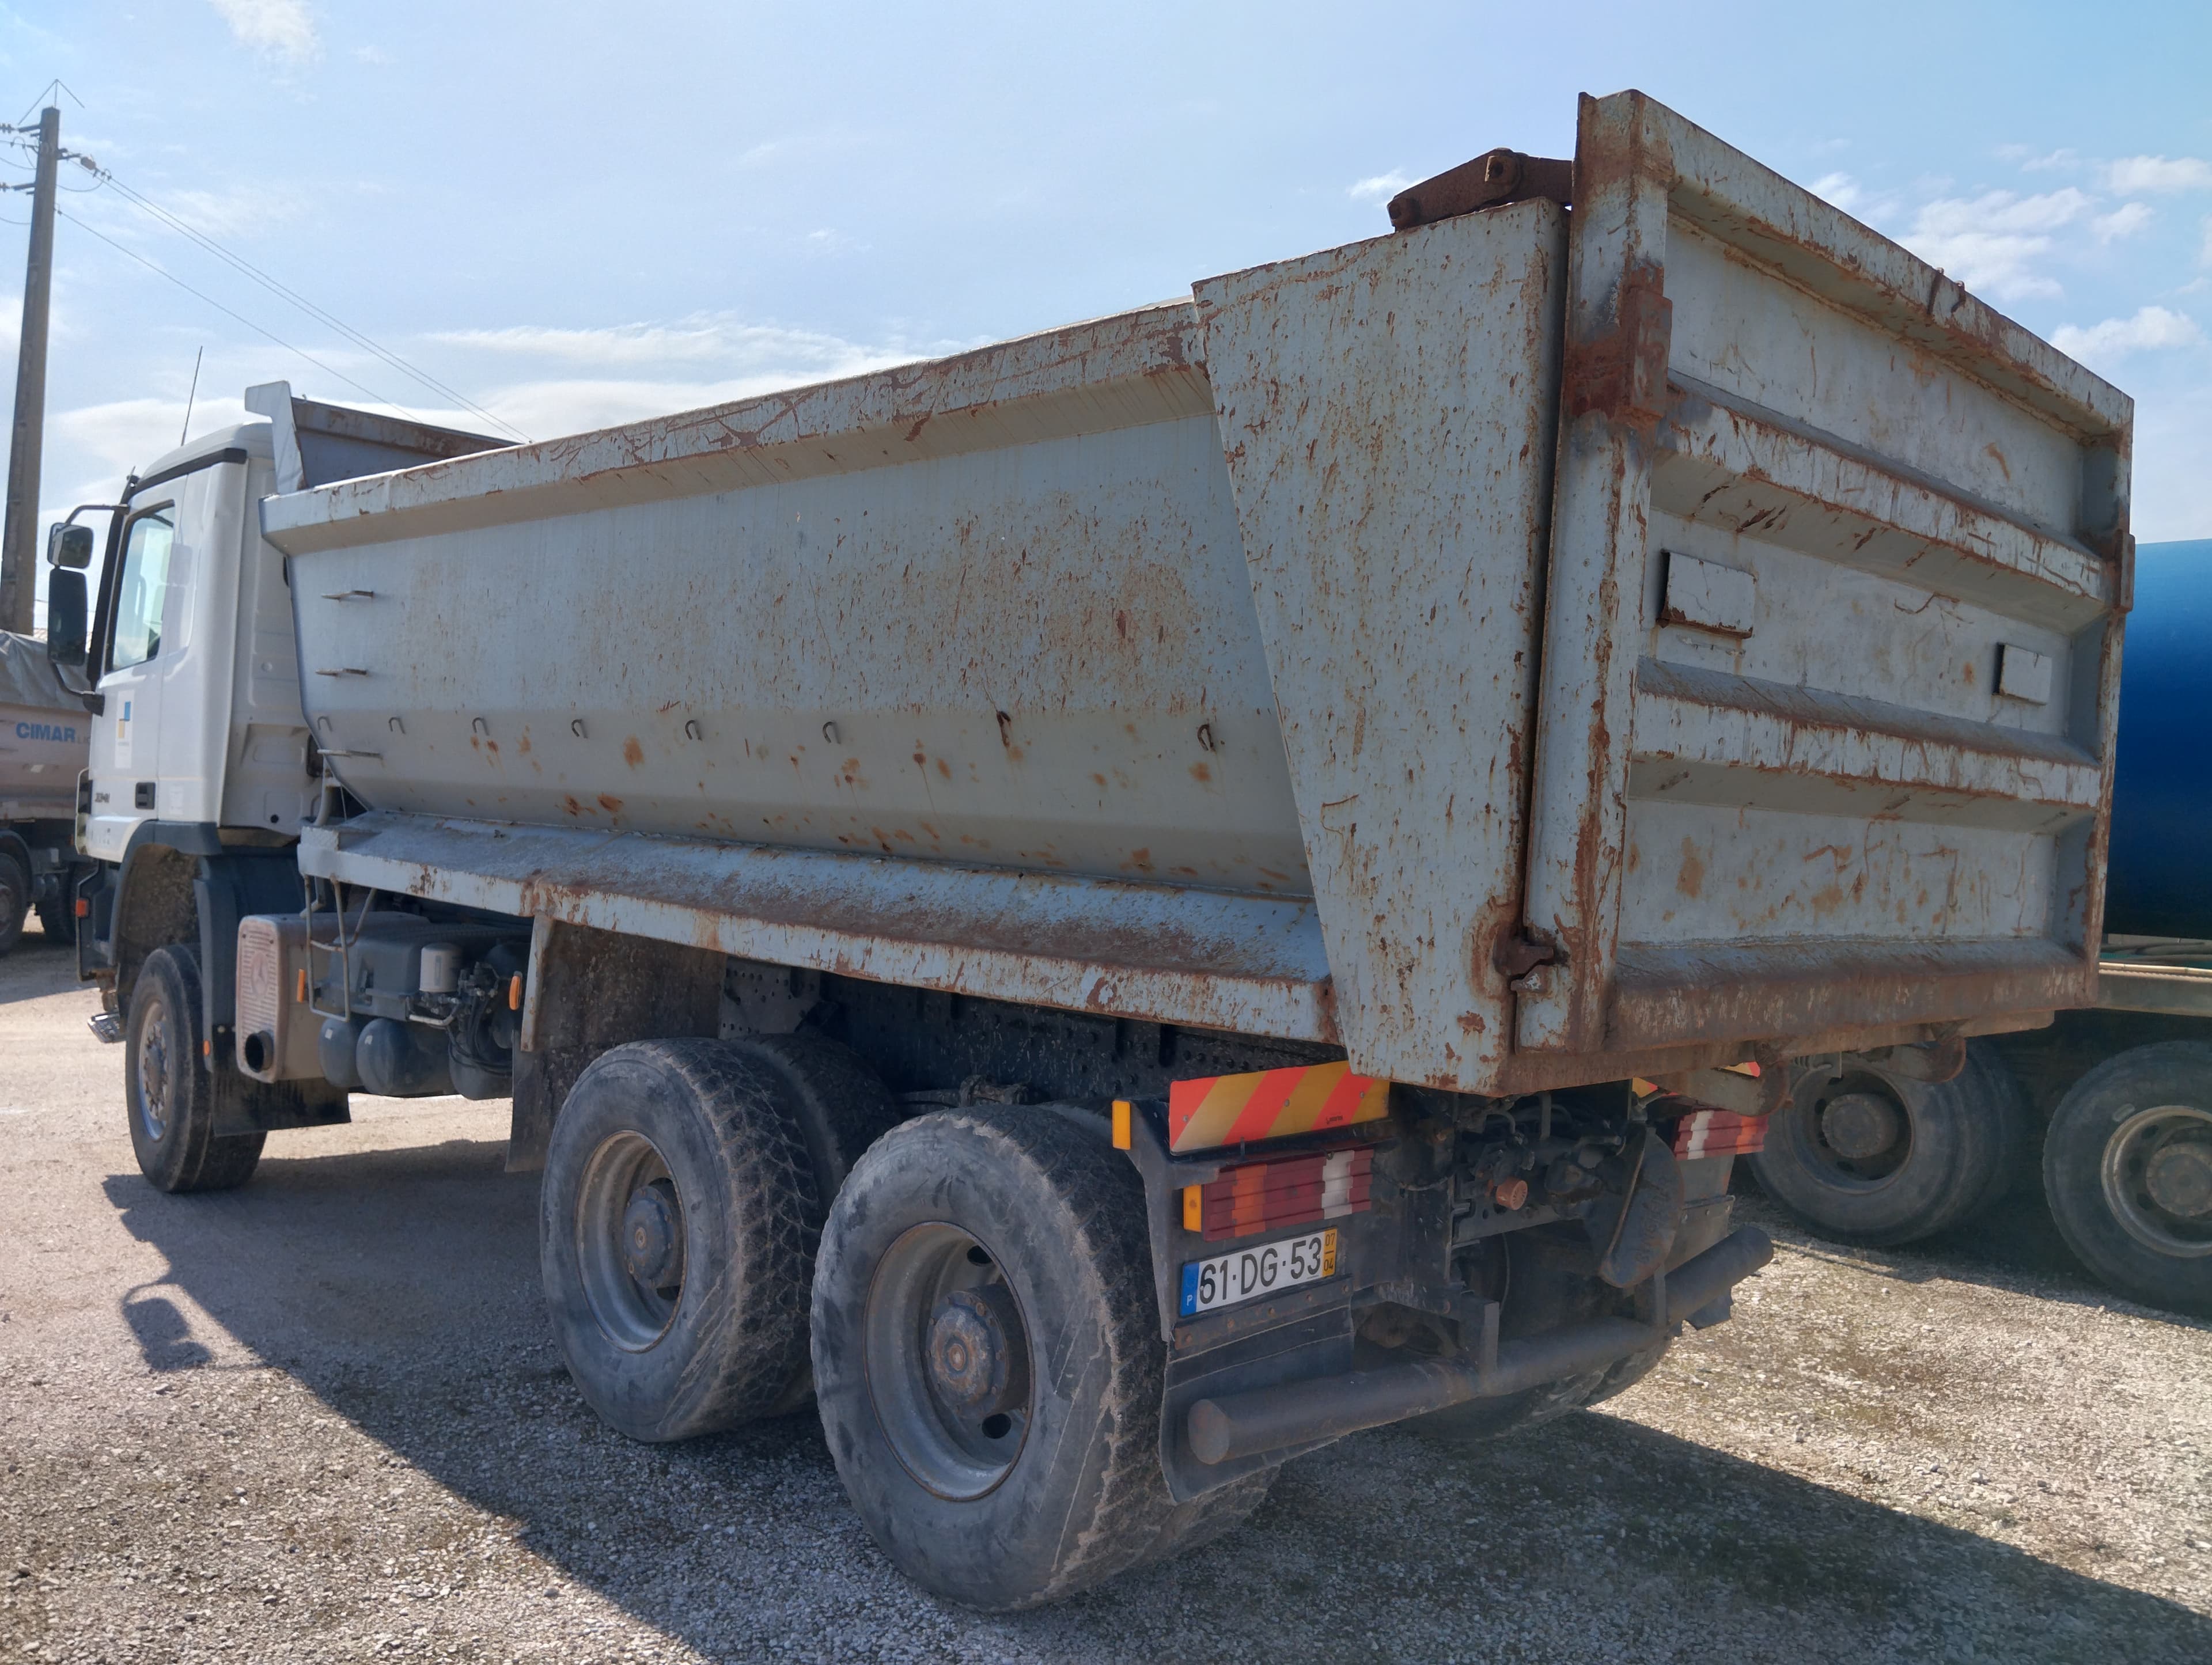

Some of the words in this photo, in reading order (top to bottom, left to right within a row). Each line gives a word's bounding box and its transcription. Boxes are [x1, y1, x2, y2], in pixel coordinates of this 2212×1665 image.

[16, 722, 75, 742] CIMAR
[1325, 1232, 1335, 1246] 07
[1324, 1258, 1333, 1272] 04
[1187, 1294, 1193, 1306] P
